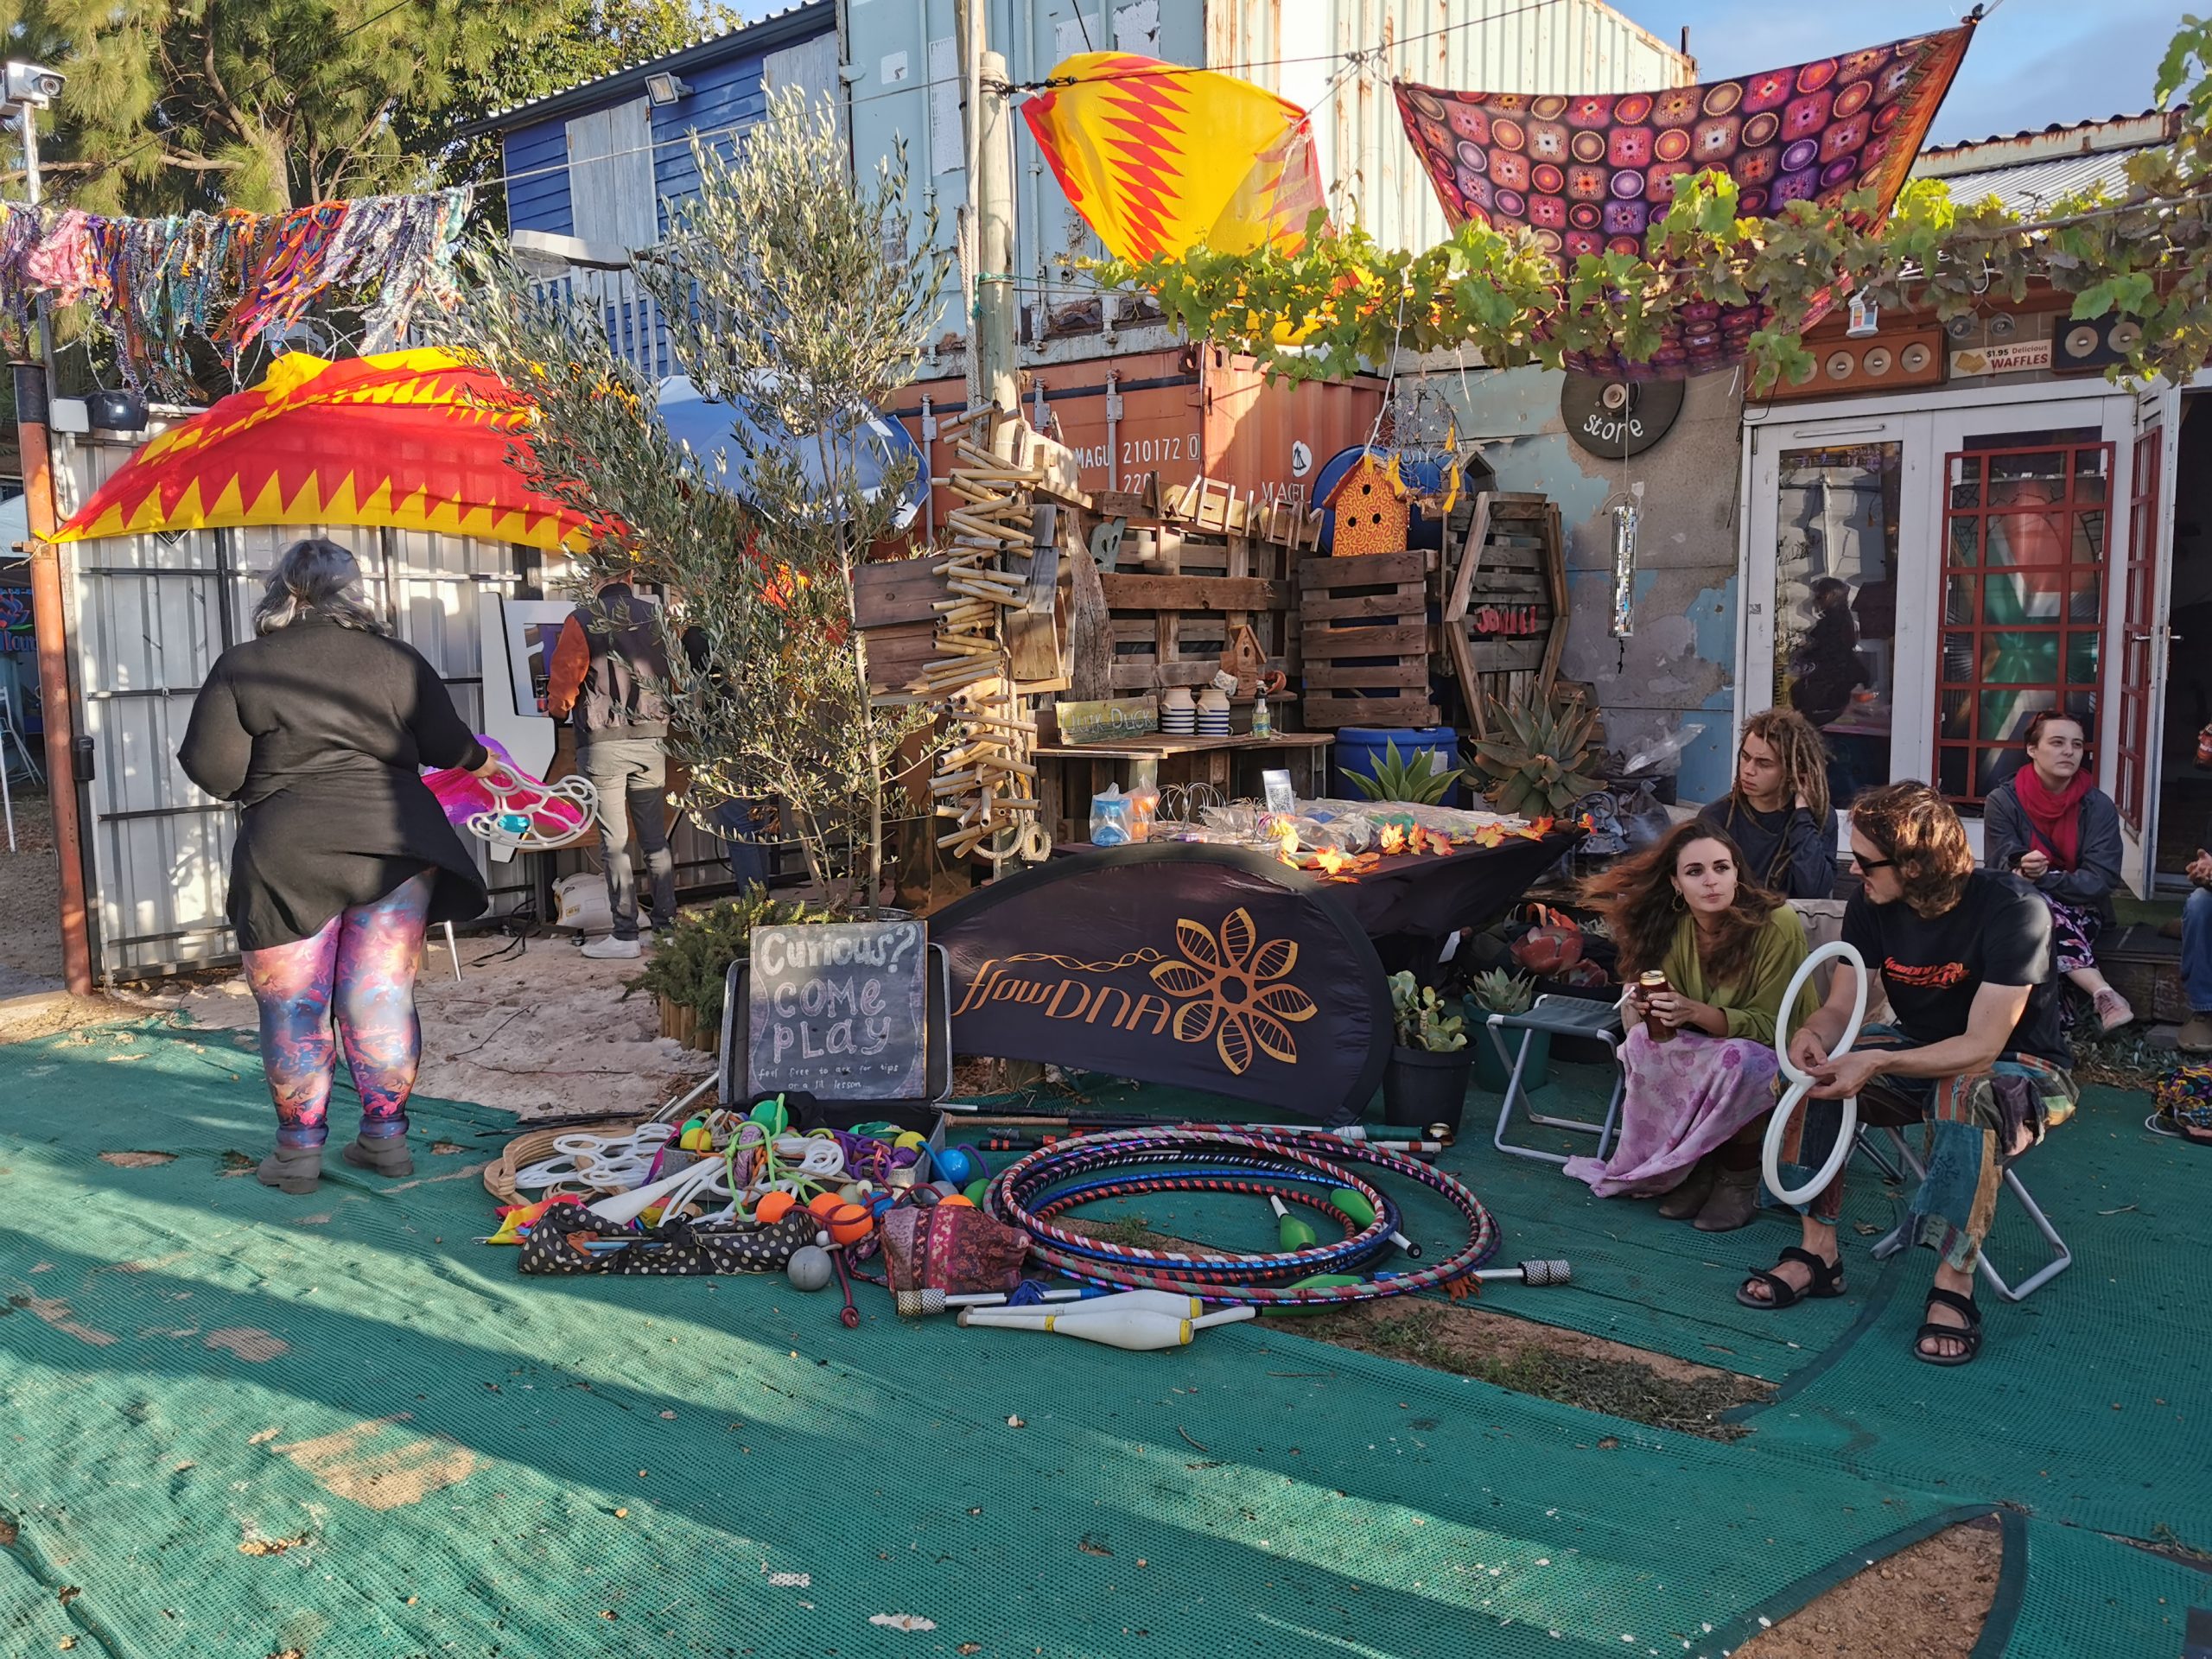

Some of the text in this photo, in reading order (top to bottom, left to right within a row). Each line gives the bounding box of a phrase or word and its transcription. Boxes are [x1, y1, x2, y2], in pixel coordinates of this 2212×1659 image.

[1986, 345, 2048, 358] $1.95 Delicious
[1991, 353, 2049, 369] WAFFLES
[1583, 414, 1644, 443] store
[1075, 445, 1110, 468] MAGU
[1123, 437, 1180, 464] 210172
[760, 923, 917, 976] Curious?
[758, 1068, 779, 1081] feel
[789, 1066, 810, 1077] free
[818, 1065, 829, 1074] to
[859, 1064, 873, 1074] for
[880, 1063, 899, 1074] tips
[788, 1081, 798, 1090] or
